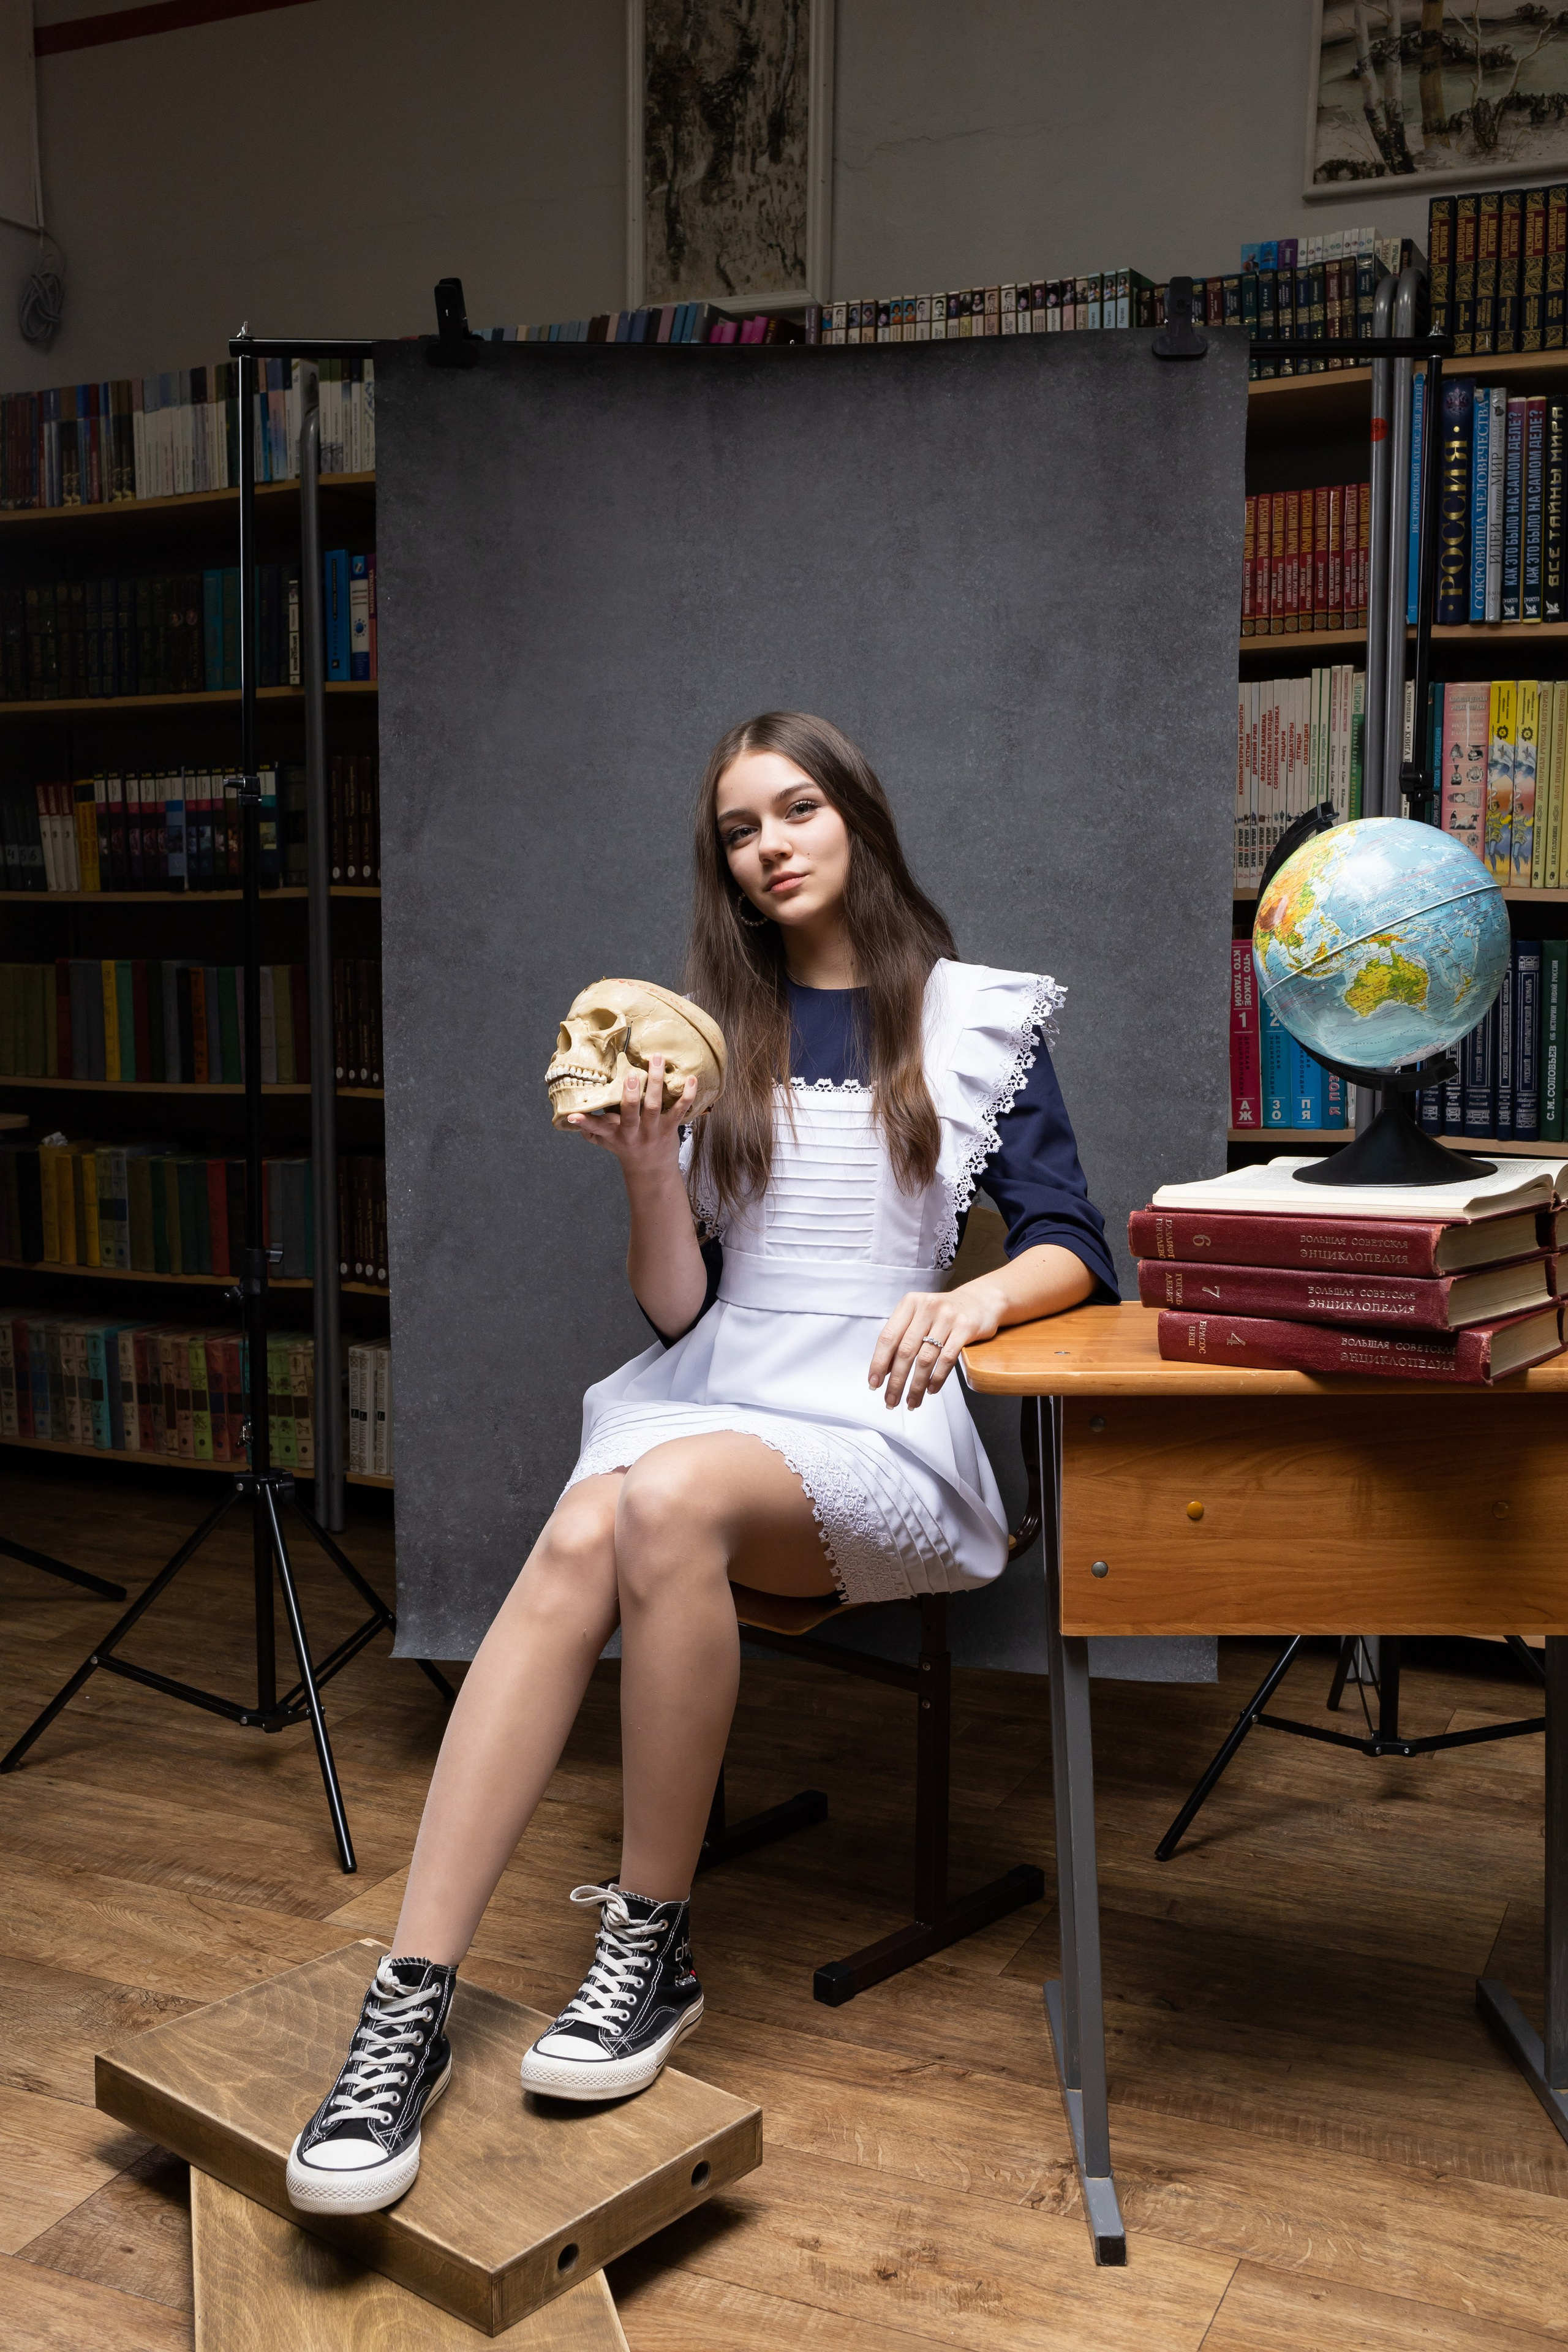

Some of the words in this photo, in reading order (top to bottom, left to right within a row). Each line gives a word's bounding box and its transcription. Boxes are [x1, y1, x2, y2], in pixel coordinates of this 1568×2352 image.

[1509, 412, 1520, 450] ДЕЛЕ?
[1530, 410, 1542, 448] ДЕЛЕ?
[1551, 406, 1562, 461] МИРА
[1476, 401, 1488, 512] ЧЕЛОВЕЧЕСТВА
[1491, 453, 1502, 486] МИР
[1507, 453, 1520, 494] САМОМ
[1528, 451, 1542, 493] САМОМ
[1288, 496, 1297, 529] РУССКИЙ
[1302, 493, 1312, 527] РУССКИЙ
[1347, 490, 1356, 524] РУССКИЙ
[1507, 497, 1519, 512] НА
[1528, 496, 1540, 511] НА
[1548, 469, 1561, 540] ТАЙНЫ
[1259, 499, 1269, 532] РУССКИЙ
[1440, 438, 1468, 600] РОССИЯ
[1302, 529, 1311, 552] НАРОД
[1346, 526, 1355, 549] НАРОД
[1506, 516, 1518, 545] БЫЛО
[1526, 515, 1540, 543] БЫЛО
[1259, 534, 1268, 557] НАРОД
[1288, 531, 1297, 554] НАРОД
[1491, 522, 1501, 564] ИДЕИ
[1476, 516, 1487, 609] СОКРОВИЩА
[1506, 547, 1518, 565] ЭТО
[1526, 546, 1539, 564] ЭТО
[1549, 545, 1560, 587] ВСЕ
[1506, 568, 1517, 585] КАК
[1526, 566, 1539, 584] КАК
[1239, 1012, 1246, 1027] 1
[1270, 1012, 1280, 1027] 2
[1241, 1101, 1249, 1109] А
[1302, 1099, 1310, 1109] П
[1302, 1110, 1310, 1120] Я
[1238, 1112, 1253, 1120] Ж
[1165, 1219, 1174, 1258] ГАЗЛИФТ
[1193, 1235, 1211, 1246] 6
[1300, 1234, 1346, 1245] БОЛЬШАЯ
[1351, 1238, 1409, 1249] СОВЕТСКАЯ
[1300, 1250, 1408, 1264] ЭНЦИКЛОПЕДИЯ
[1202, 1286, 1219, 1298] 7
[1308, 1287, 1354, 1296] БОЛЬШАЯ
[1360, 1290, 1415, 1300] СОВЕТСКАЯ
[1308, 1299, 1415, 1313] ЭНЦИКЛОПЕДИЯ
[1226, 1332, 1246, 1346] 4
[1341, 1338, 1389, 1349] БОЛЬШАЯ
[1396, 1343, 1455, 1355] СОВЕТСКАЯ
[1340, 1352, 1455, 1370] ЭНЦИКЛОПЕДИЯ
